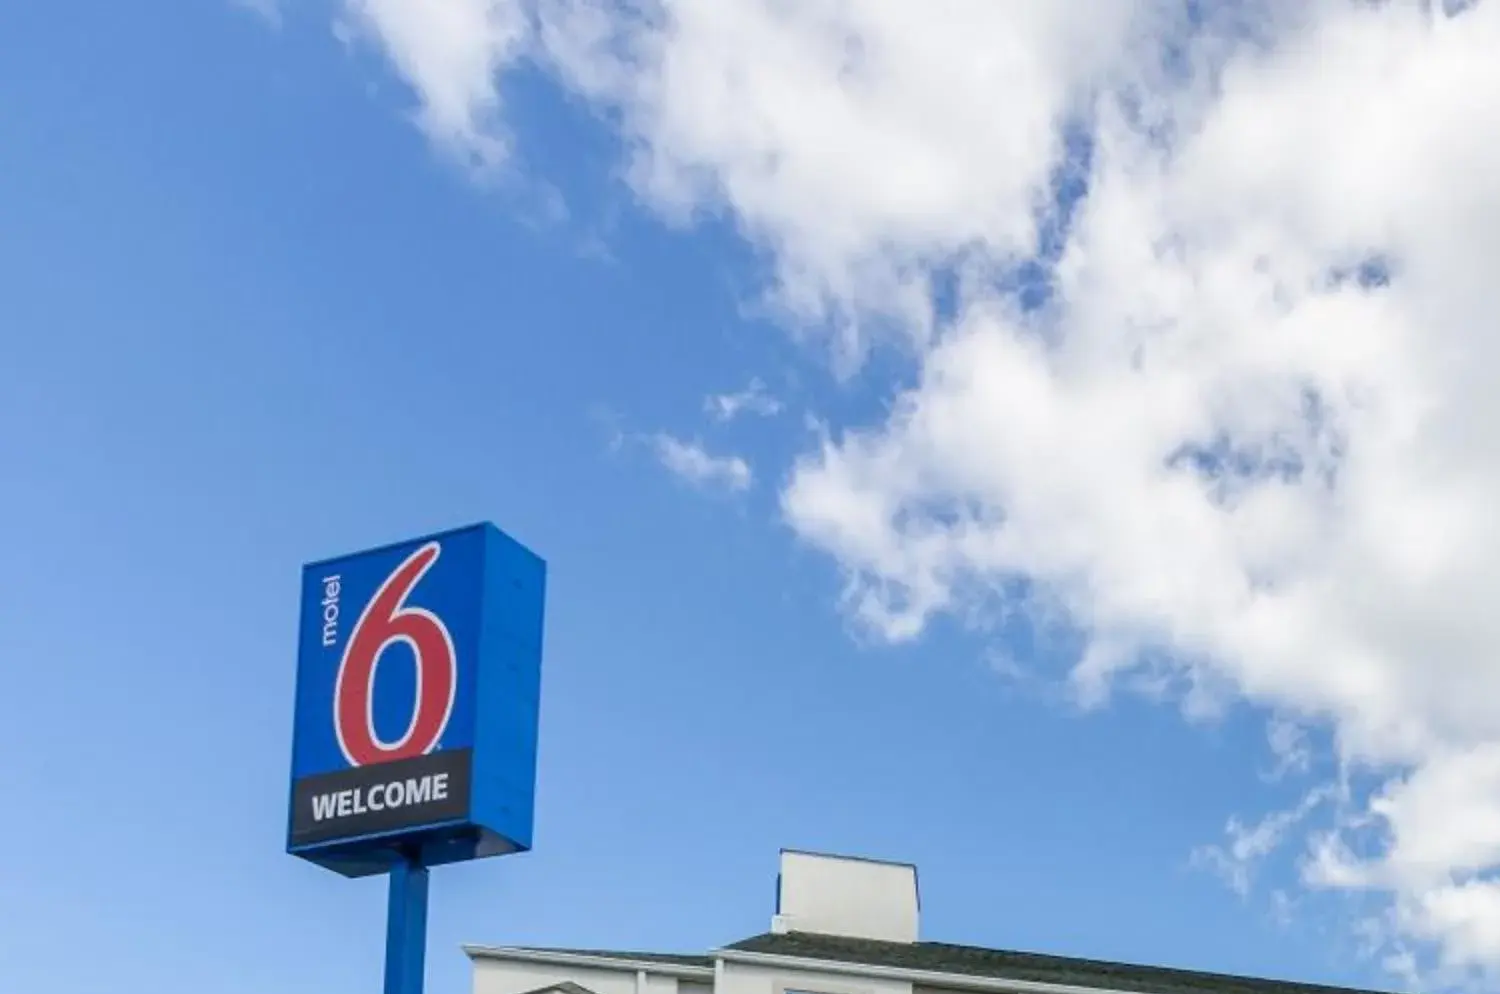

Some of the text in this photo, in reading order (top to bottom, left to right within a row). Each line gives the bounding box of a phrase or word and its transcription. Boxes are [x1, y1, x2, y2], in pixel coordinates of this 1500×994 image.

[321, 574, 341, 647] motel
[334, 540, 457, 767] 6
[312, 773, 449, 822] WELCOME
